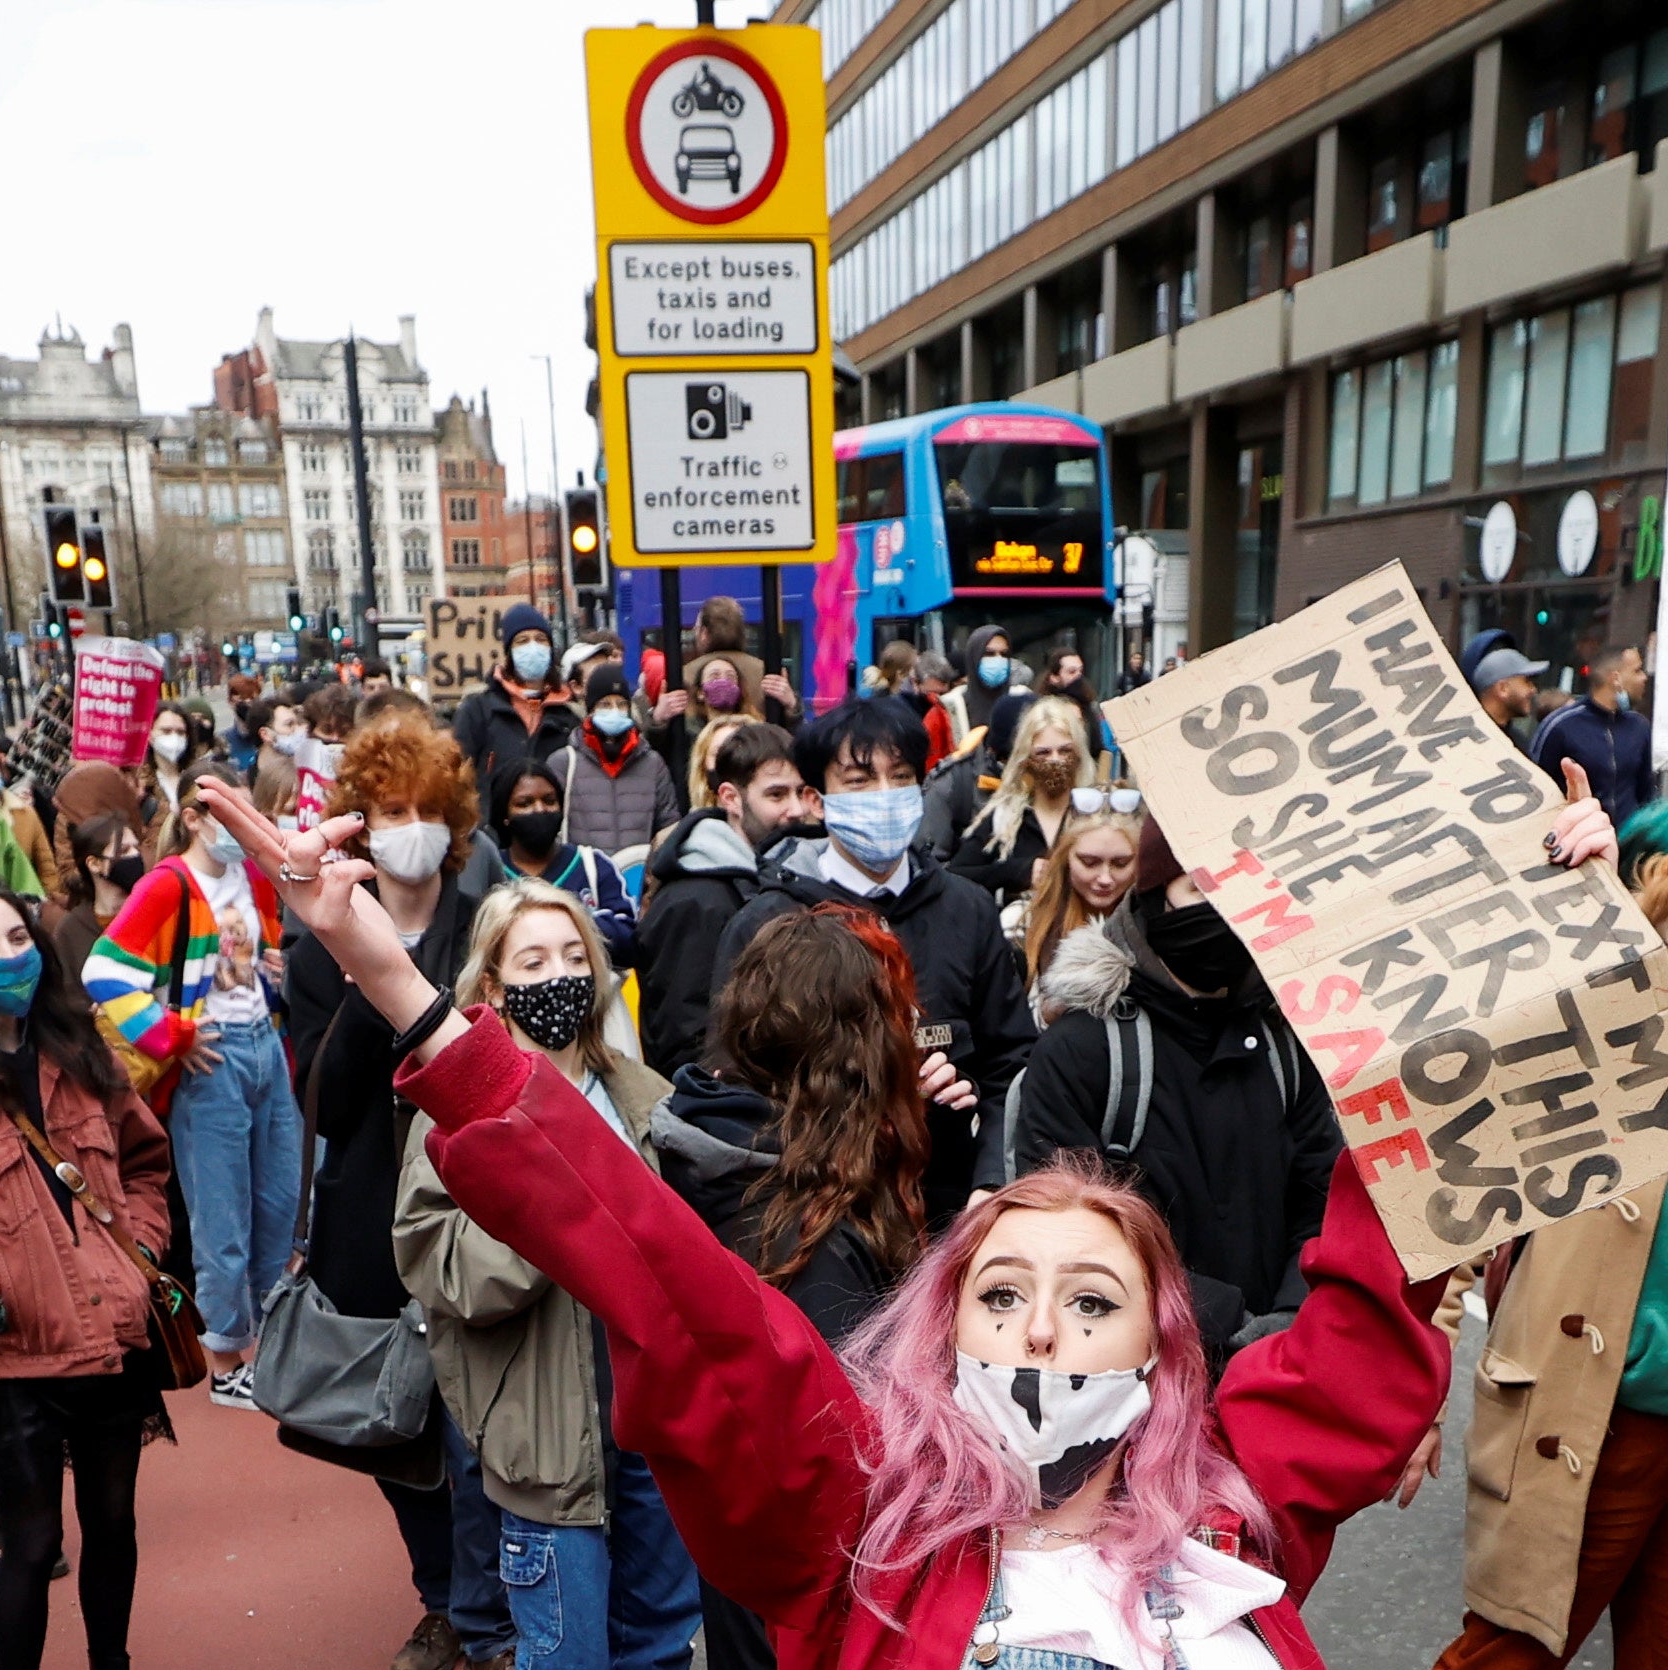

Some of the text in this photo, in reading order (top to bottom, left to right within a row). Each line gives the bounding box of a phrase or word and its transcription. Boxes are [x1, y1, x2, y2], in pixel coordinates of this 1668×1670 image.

[624, 257, 801, 283] Except buses,
[657, 286, 771, 311] taxis and
[647, 317, 784, 345] for loading
[680, 454, 763, 479] Traffic
[643, 483, 801, 509] enforcement
[672, 514, 776, 537] cameras
[1346, 587, 1406, 628] I
[81, 656, 156, 682] Defend the
[80, 676, 138, 699] right to
[1364, 616, 1493, 767] HAVE
[80, 695, 134, 717] protest
[1469, 755, 1545, 826] TO
[1274, 647, 1622, 1219] MUM AFTER THIS
[1520, 860, 1652, 994] TEXT
[1179, 683, 1524, 1248] SO SHE KNOWS
[1191, 846, 1432, 1188] I'M SAFE
